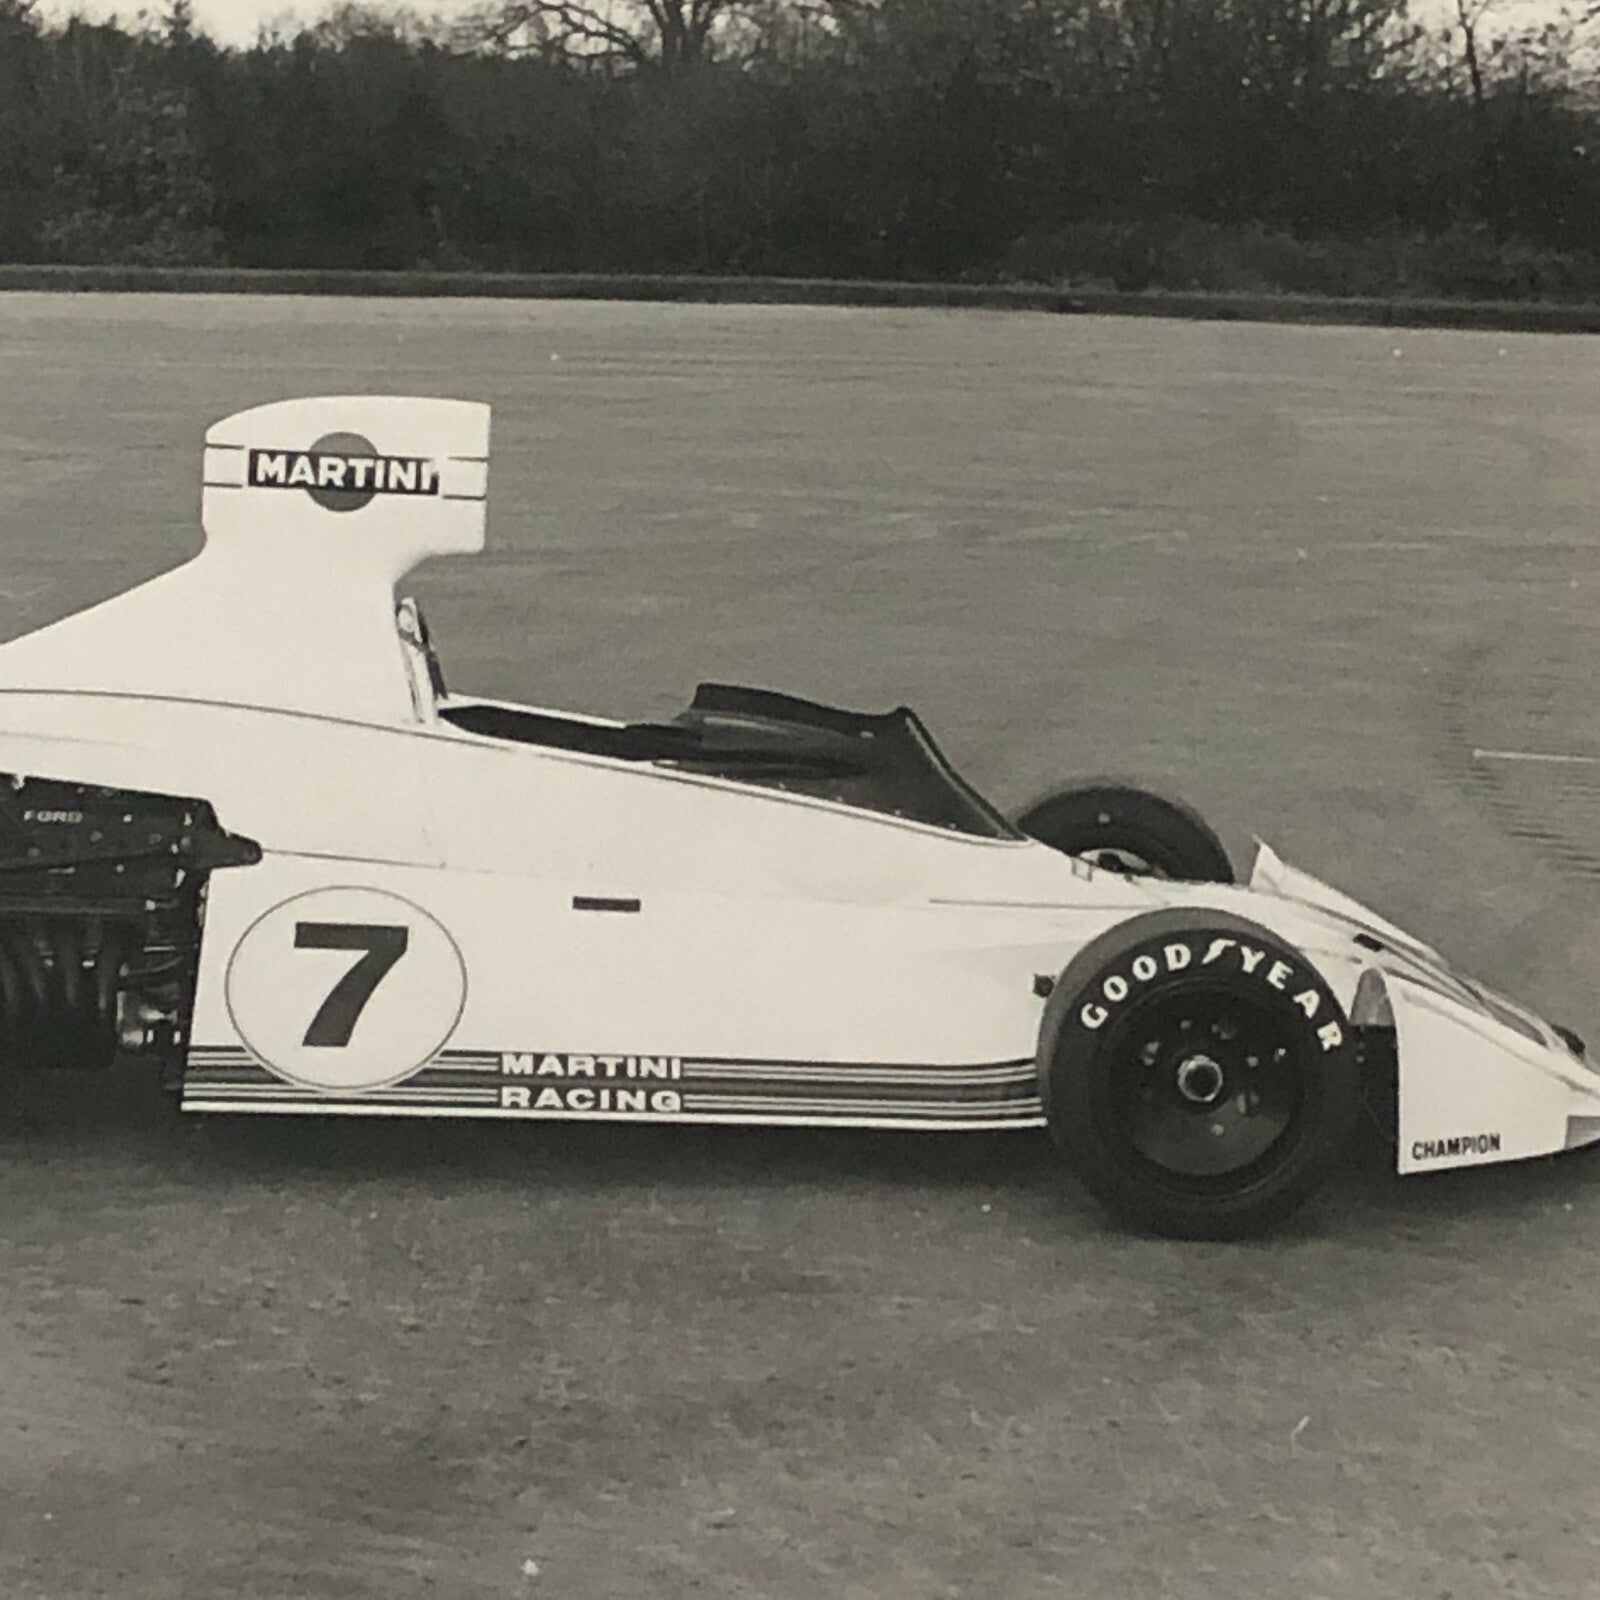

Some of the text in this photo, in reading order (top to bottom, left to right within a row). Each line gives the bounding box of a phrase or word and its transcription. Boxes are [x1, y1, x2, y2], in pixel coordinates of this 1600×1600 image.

[256, 452, 438, 491] MARTINI
[293, 921, 409, 1047] 7
[502, 1053, 681, 1080] MARTINI
[501, 1086, 681, 1112] RACING
[1412, 1133, 1501, 1161] CHAMPION
